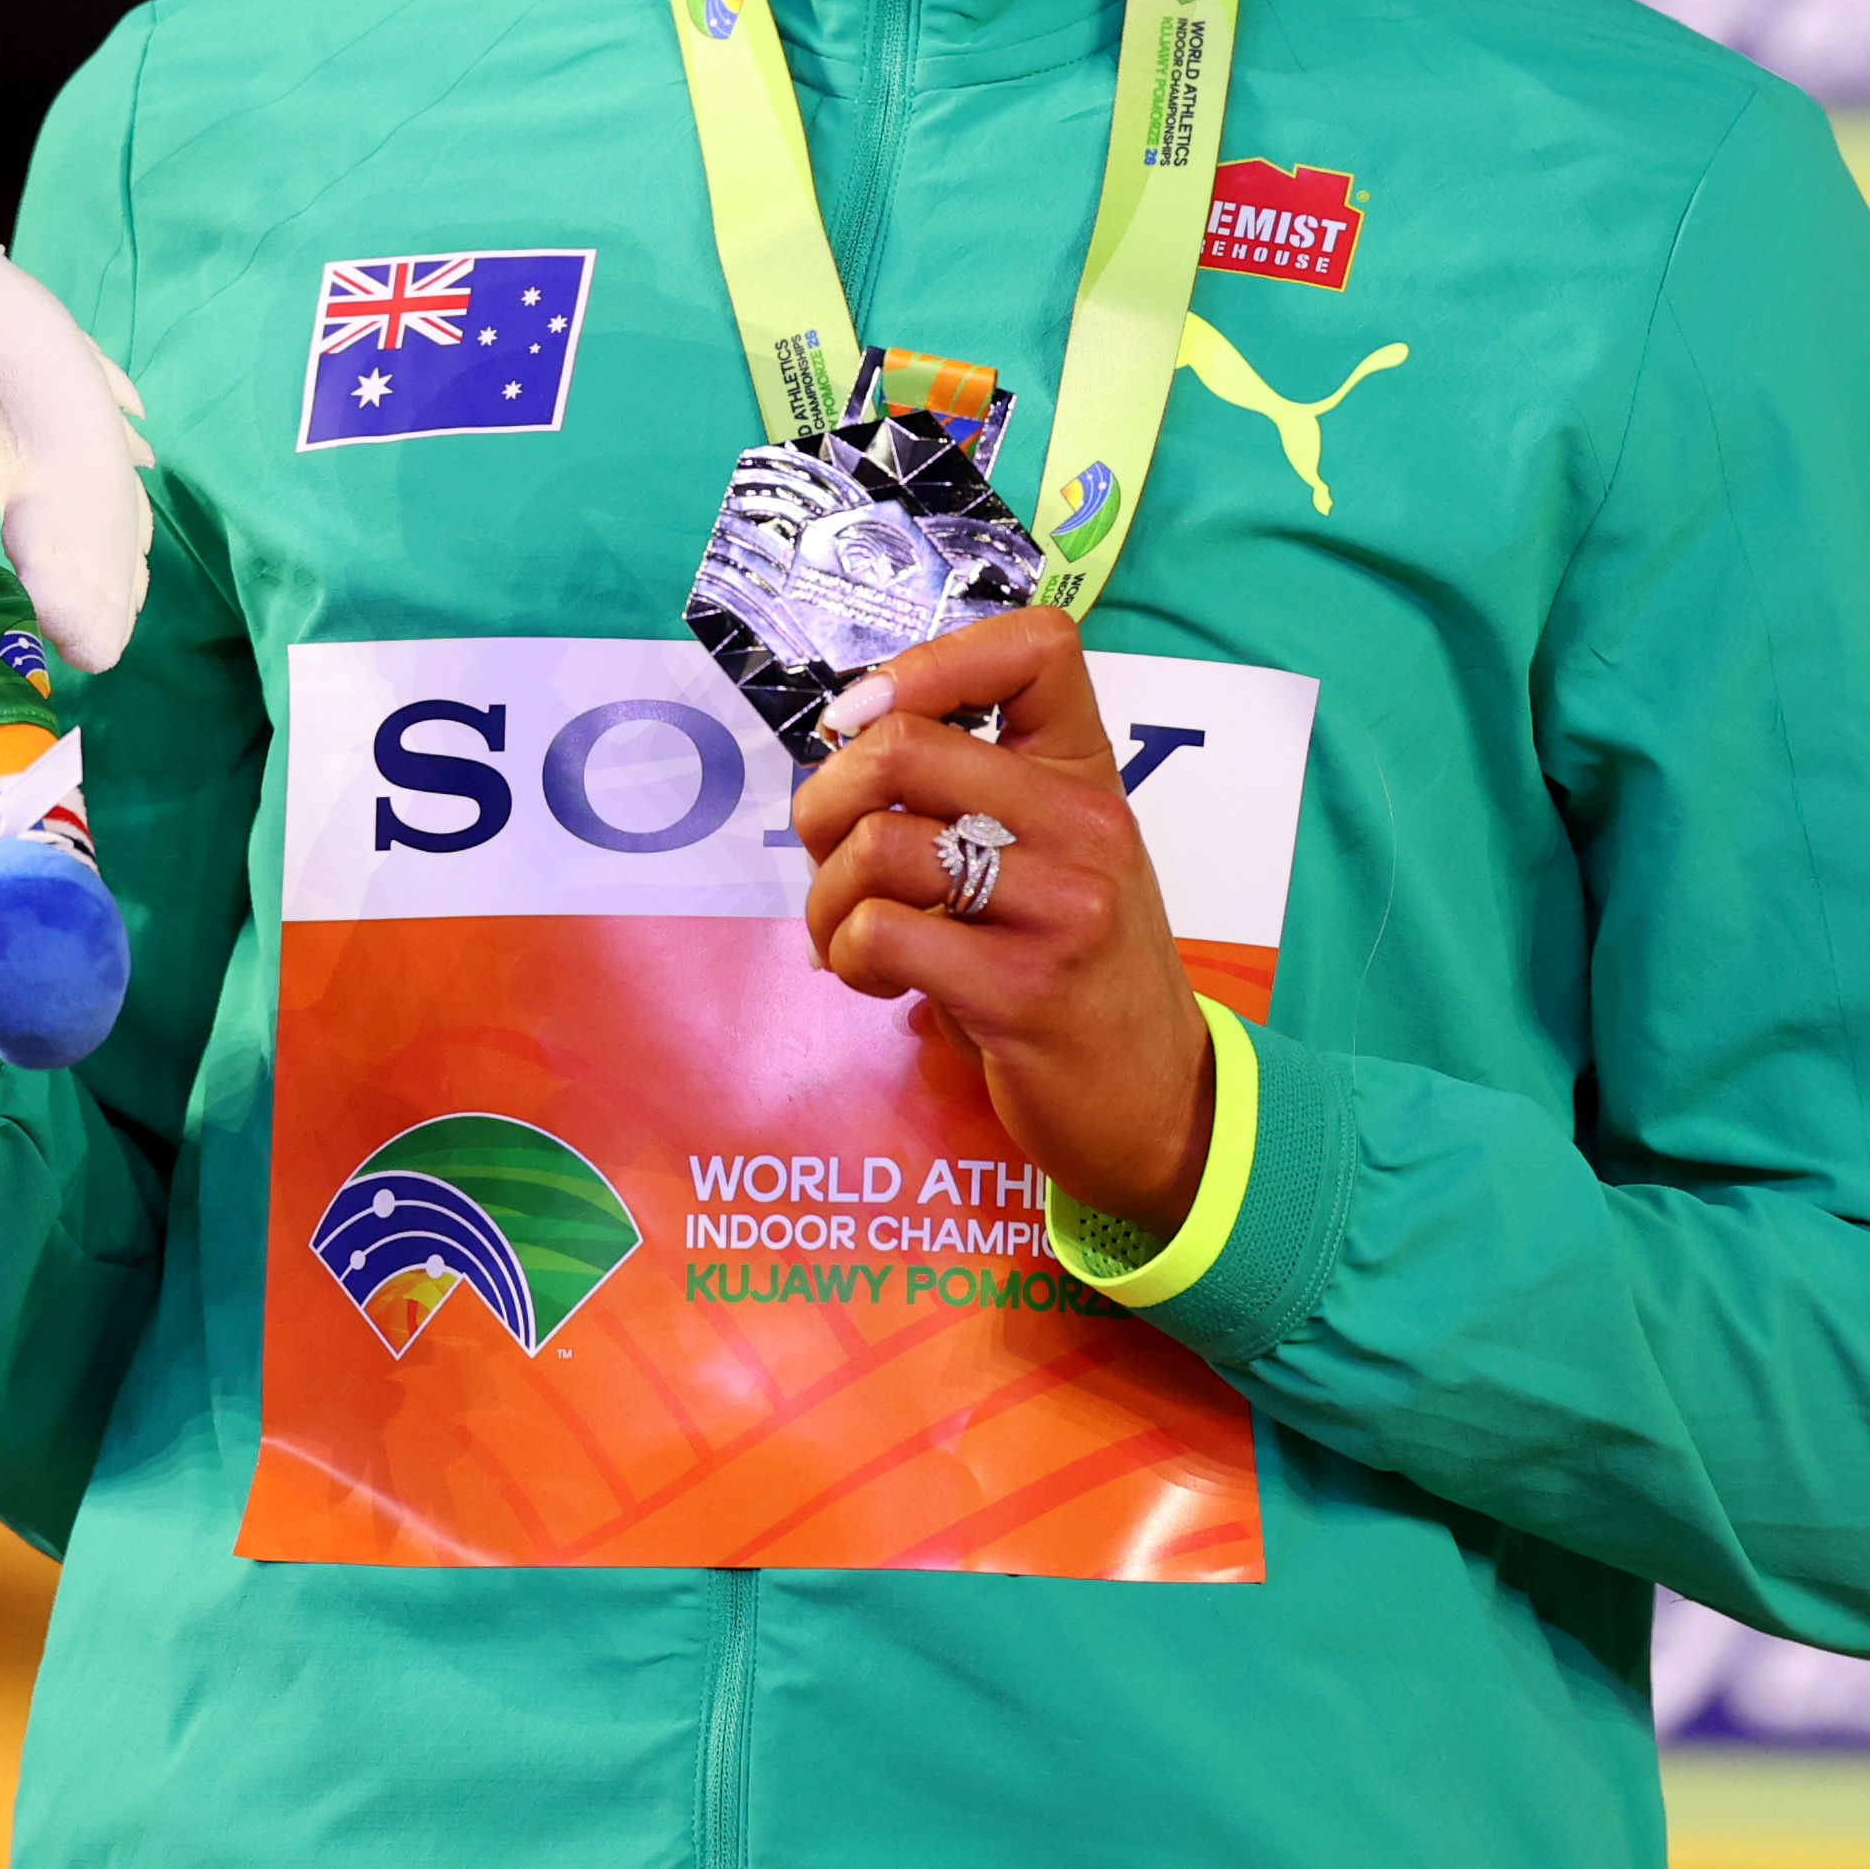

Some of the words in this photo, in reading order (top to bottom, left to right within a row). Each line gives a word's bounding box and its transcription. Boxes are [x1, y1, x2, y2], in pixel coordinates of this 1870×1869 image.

[1156, 16, 1173, 75] KUJAWY
[1173, 17, 1188, 67] INDOOR
[1185, 20, 1205, 80] WORLD
[1146, 78, 1166, 146] POMORZE
[1159, 69, 1182, 166] CHAMPIONSHIPS
[1173, 83, 1197, 167] ATHLETICS
[1144, 148, 1158, 165] 26
[1207, 200, 1348, 253] EMIST
[1200, 240, 1330, 273] EHOUSE
[805, 329, 820, 349] 26
[774, 338, 809, 420] ATHLETICS
[791, 334, 825, 430] CHAMPIONSHIPS
[811, 349, 838, 417] POMORZE
[688, 1154, 902, 1204] WORLD
[685, 1213, 856, 1250] INDOOR
[685, 1263, 893, 1304] KUJAWY
